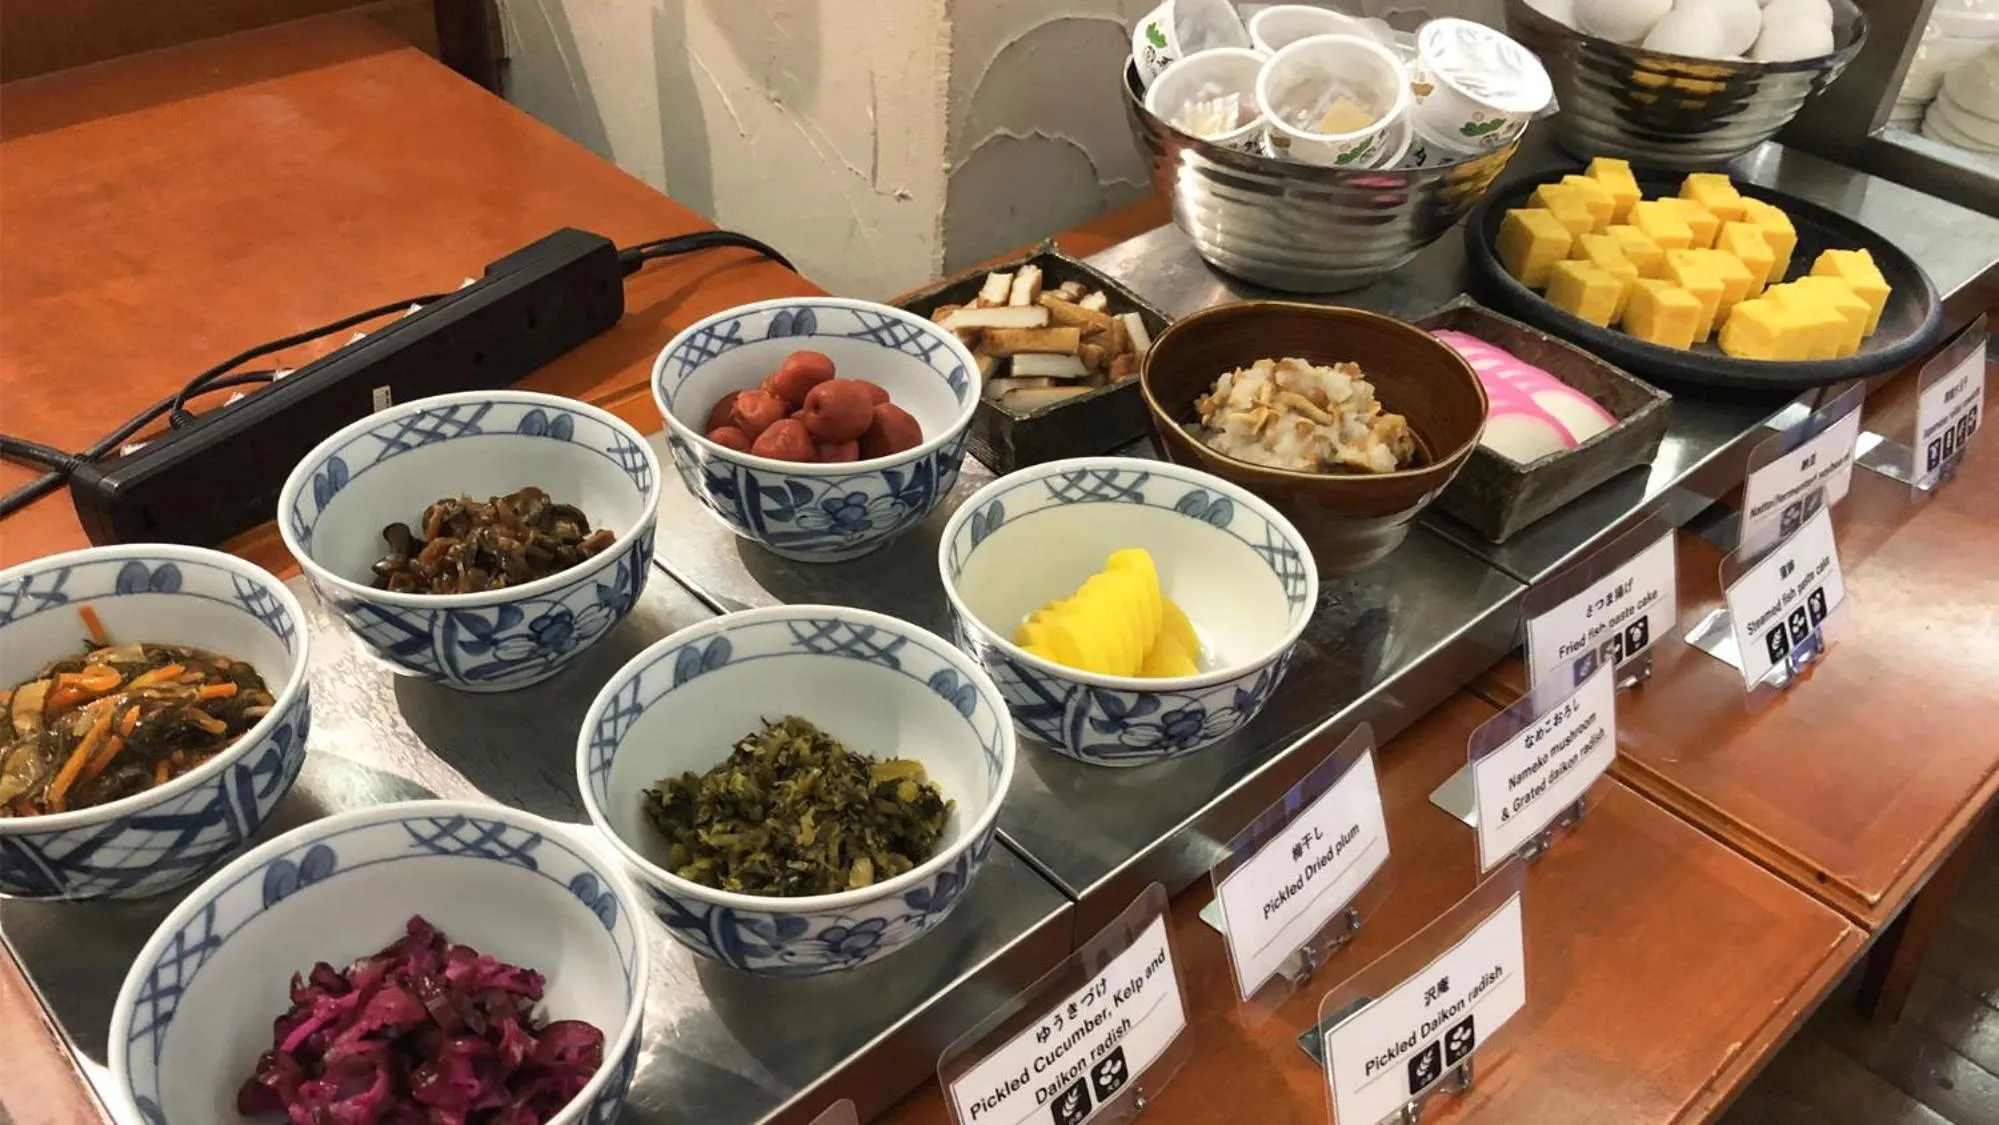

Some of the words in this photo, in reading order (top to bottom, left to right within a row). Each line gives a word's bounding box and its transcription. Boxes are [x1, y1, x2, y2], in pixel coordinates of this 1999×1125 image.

[1558, 634, 1586, 659] Fried
[1636, 588, 1659, 610] cake
[1747, 599, 1782, 636] Steamed
[1782, 588, 1797, 606] fish
[1797, 570, 1815, 595] paste
[1508, 750, 1549, 791] Nameko
[1549, 711, 1599, 757] mushroom
[1523, 700, 1580, 749] なめこおろし
[1501, 805, 1511, 822] &
[1512, 776, 1547, 811] Grated
[1547, 751, 1579, 788] daikon
[1580, 727, 1605, 766] radish
[1262, 872, 1304, 920] Pickled
[1305, 845, 1335, 882] Dried
[1335, 822, 1361, 860] plum
[1291, 827, 1324, 862] 梅干し
[969, 1067, 1030, 1121] Pickled
[1033, 1006, 1113, 1074] Cucumber,
[1113, 976, 1144, 1009] Kelp
[1143, 949, 1167, 979] and
[1036, 977, 1108, 1044] ゆうきづけ
[1364, 1031, 1417, 1077] Pickled
[1420, 995, 1466, 1040] Daikon
[1467, 965, 1503, 1009] radish
[1034, 1056, 1088, 1105] Daikon
[1089, 1018, 1132, 1062] radish
